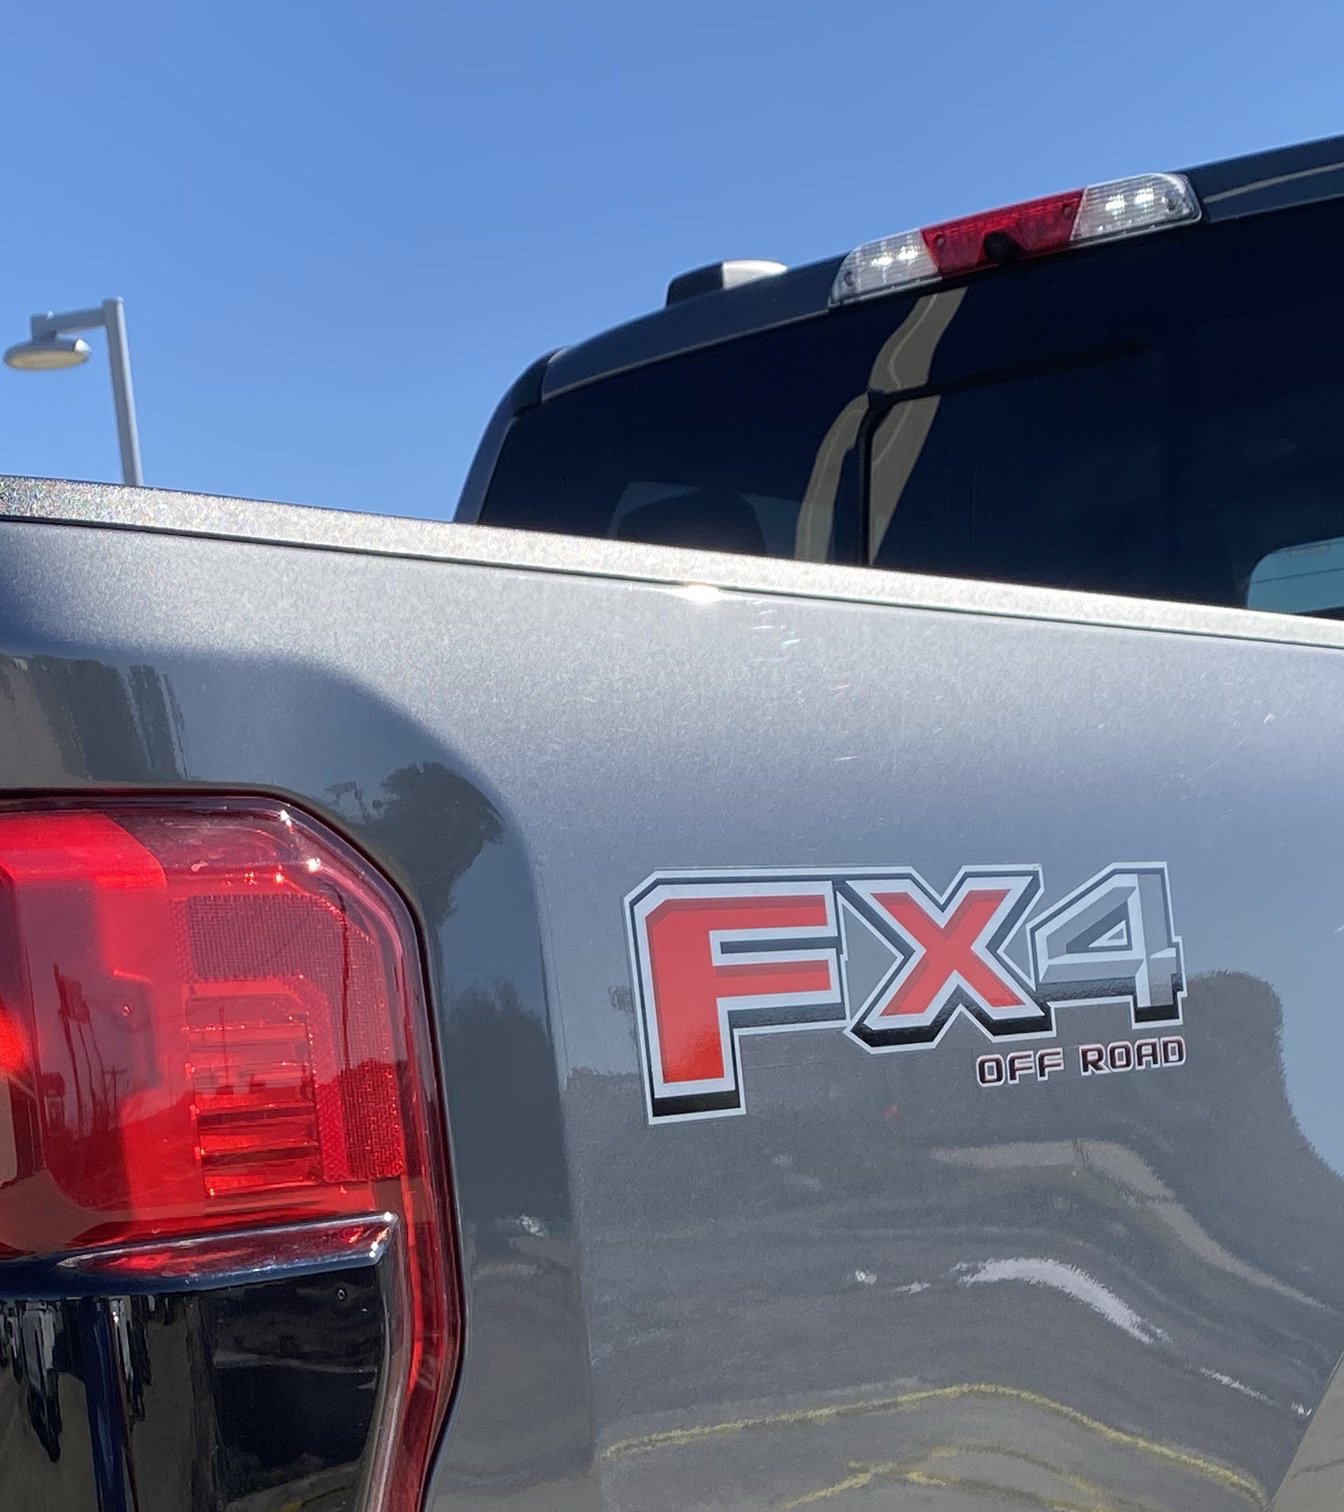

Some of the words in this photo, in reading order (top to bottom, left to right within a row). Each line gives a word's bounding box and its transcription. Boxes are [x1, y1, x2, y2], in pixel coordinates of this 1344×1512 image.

[624, 861, 1187, 1125] FX4
[976, 1048, 1064, 1087] OFF
[1078, 1036, 1187, 1076] ROAD
